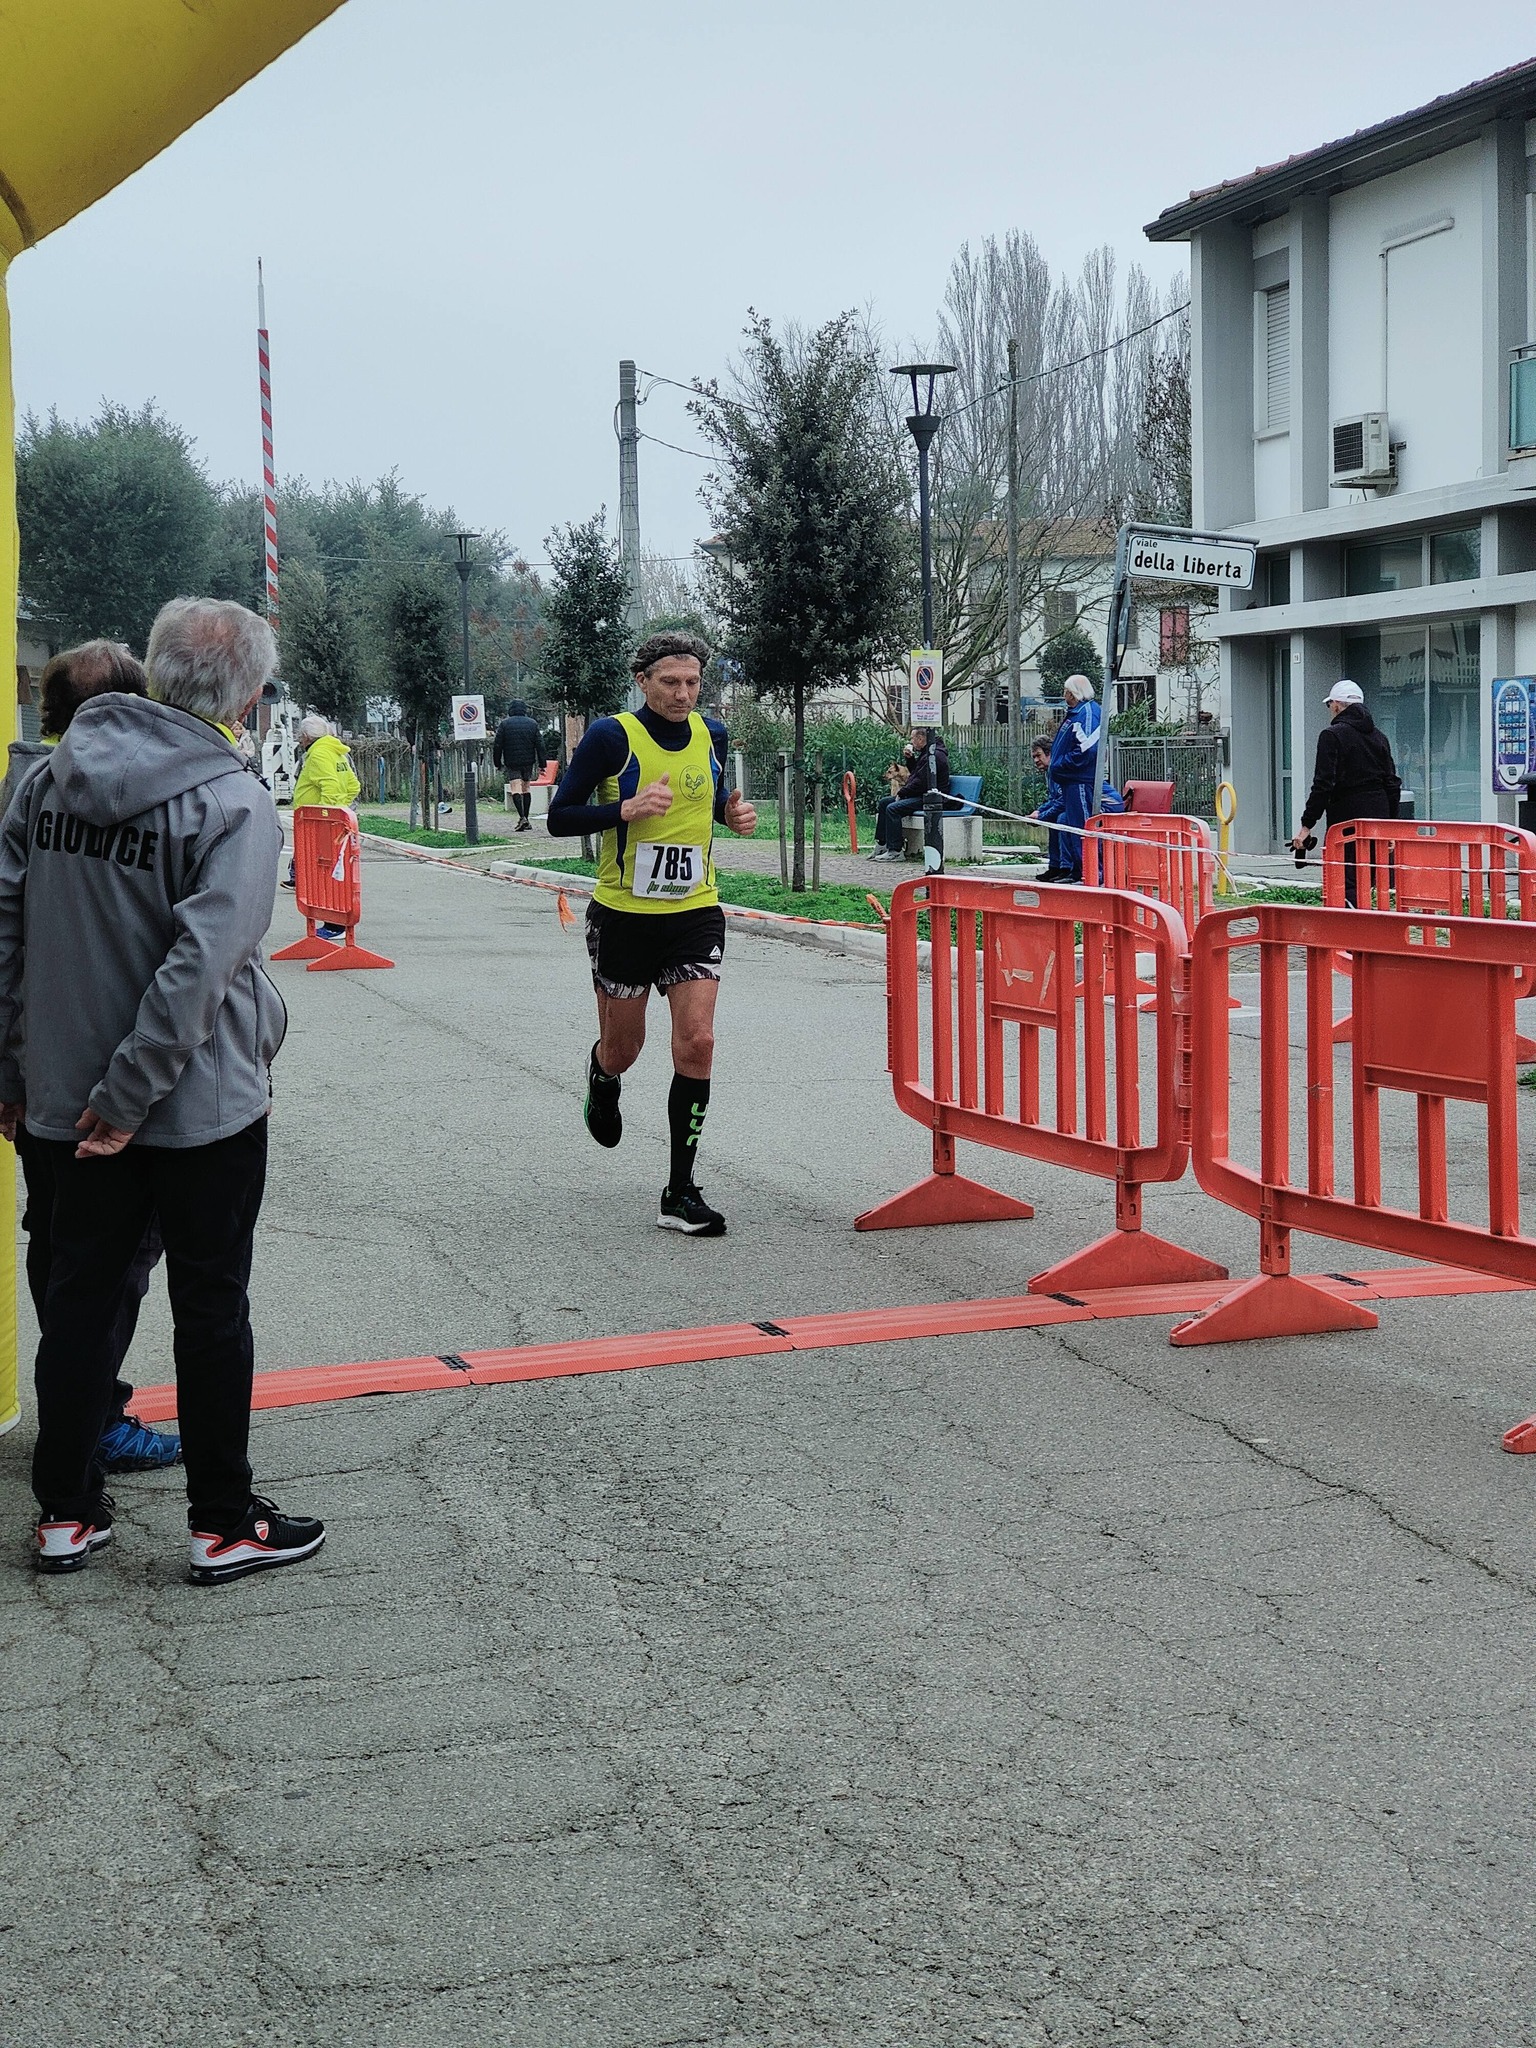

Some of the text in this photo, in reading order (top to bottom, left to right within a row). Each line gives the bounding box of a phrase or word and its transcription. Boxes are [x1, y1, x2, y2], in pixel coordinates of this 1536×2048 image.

[1136, 539, 1158, 548] viale
[1135, 551, 1175, 571] della
[35, 810, 159, 873] GIUDICE
[651, 846, 693, 880] 785
